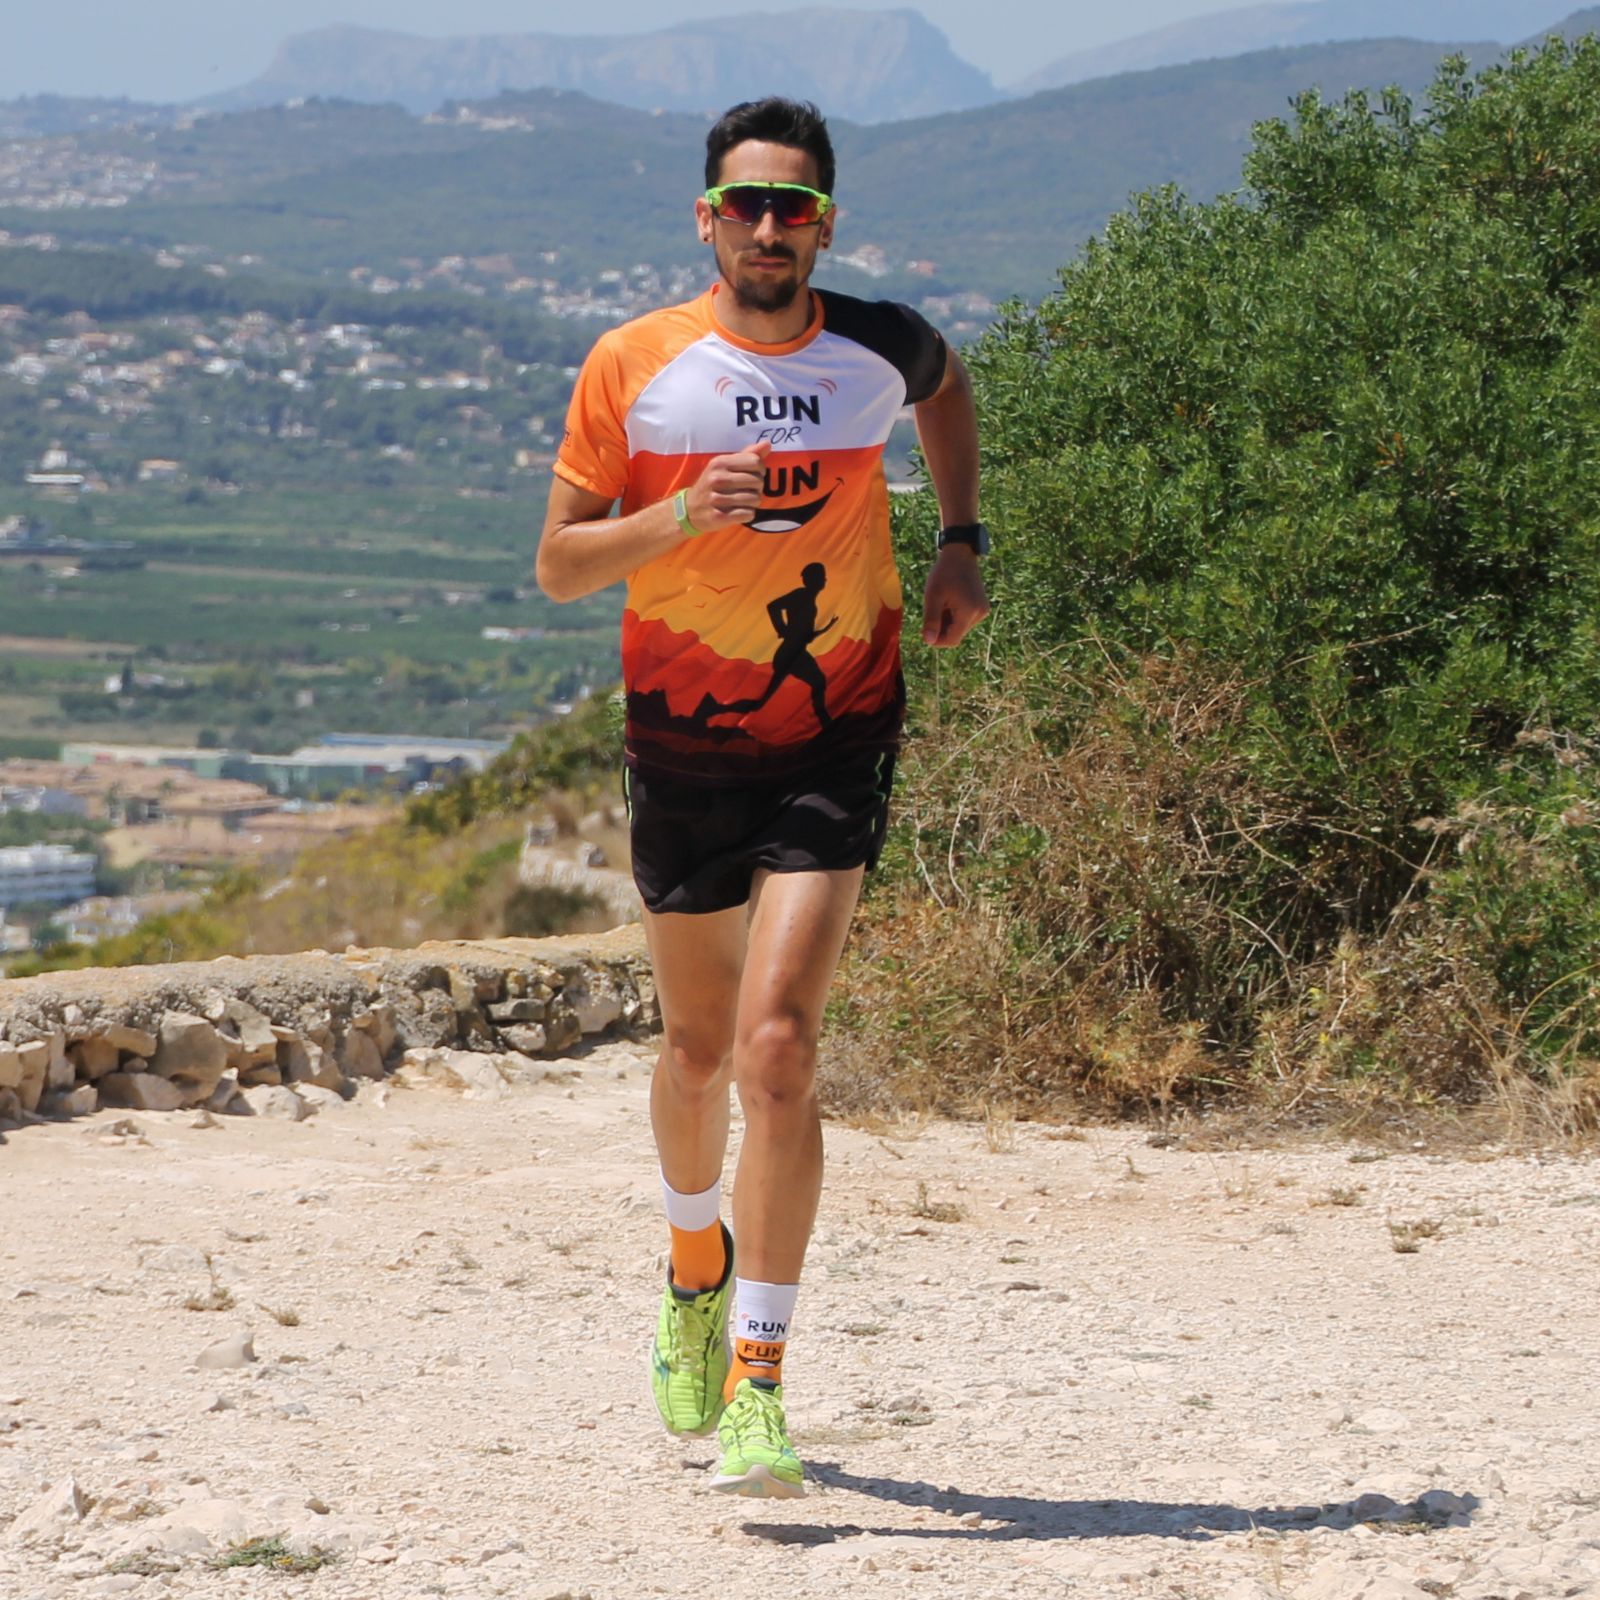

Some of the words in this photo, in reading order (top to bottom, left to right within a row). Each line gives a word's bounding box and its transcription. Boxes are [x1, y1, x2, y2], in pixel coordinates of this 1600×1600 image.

[736, 395, 820, 427] RUN
[756, 426, 801, 444] FOR
[763, 461, 819, 498] UN
[748, 1320, 787, 1334] RUN
[744, 1343, 782, 1357] FUN
